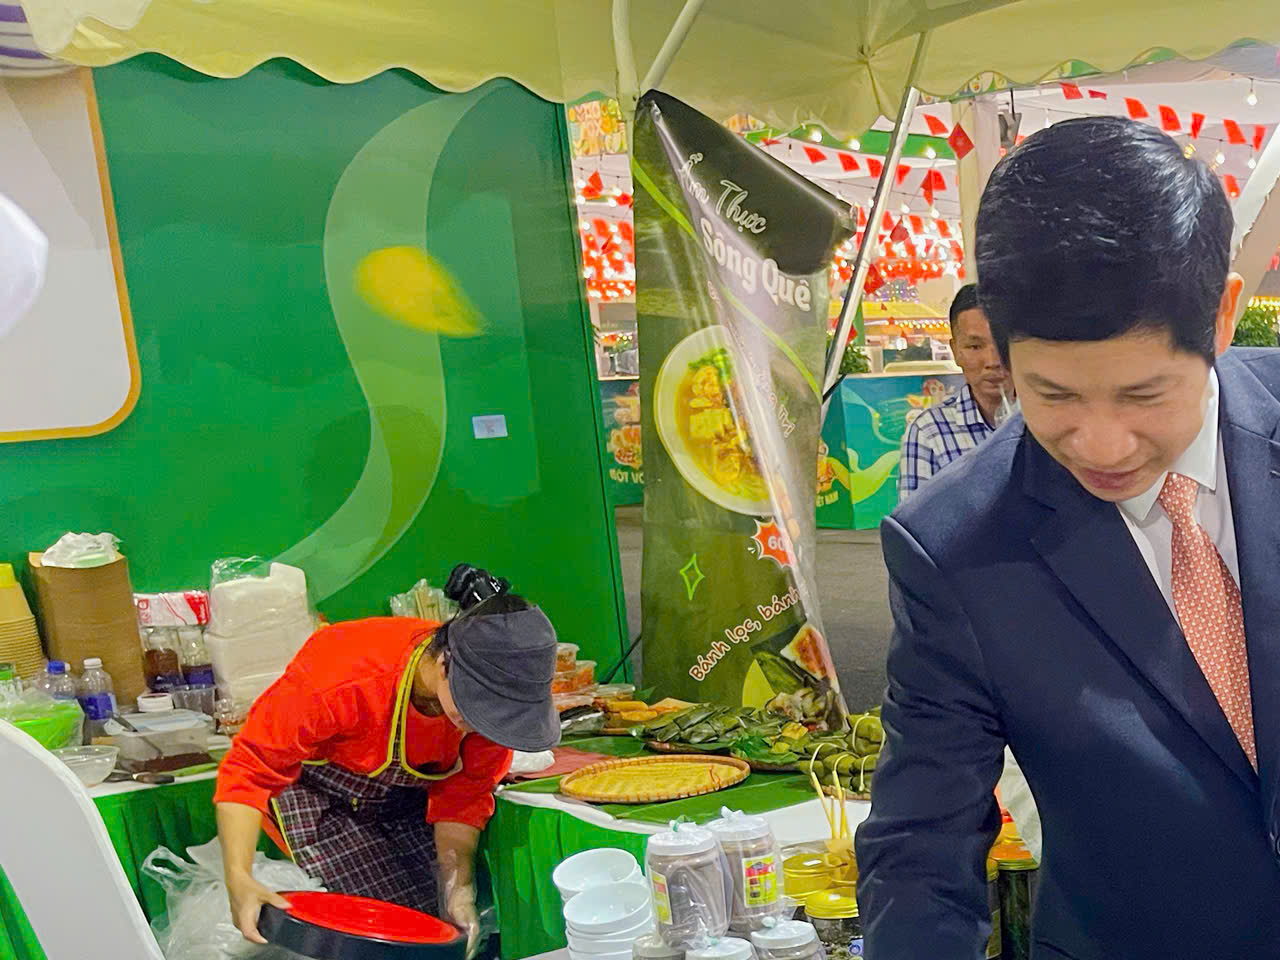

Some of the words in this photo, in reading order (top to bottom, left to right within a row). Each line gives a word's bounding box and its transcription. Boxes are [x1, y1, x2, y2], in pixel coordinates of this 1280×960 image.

[715, 179, 766, 234] Thực
[701, 217, 758, 294] Sông
[762, 258, 811, 312] Quê
[689, 640, 731, 681] Bánh
[725, 618, 761, 643] lọc,
[757, 585, 800, 621] bánh
